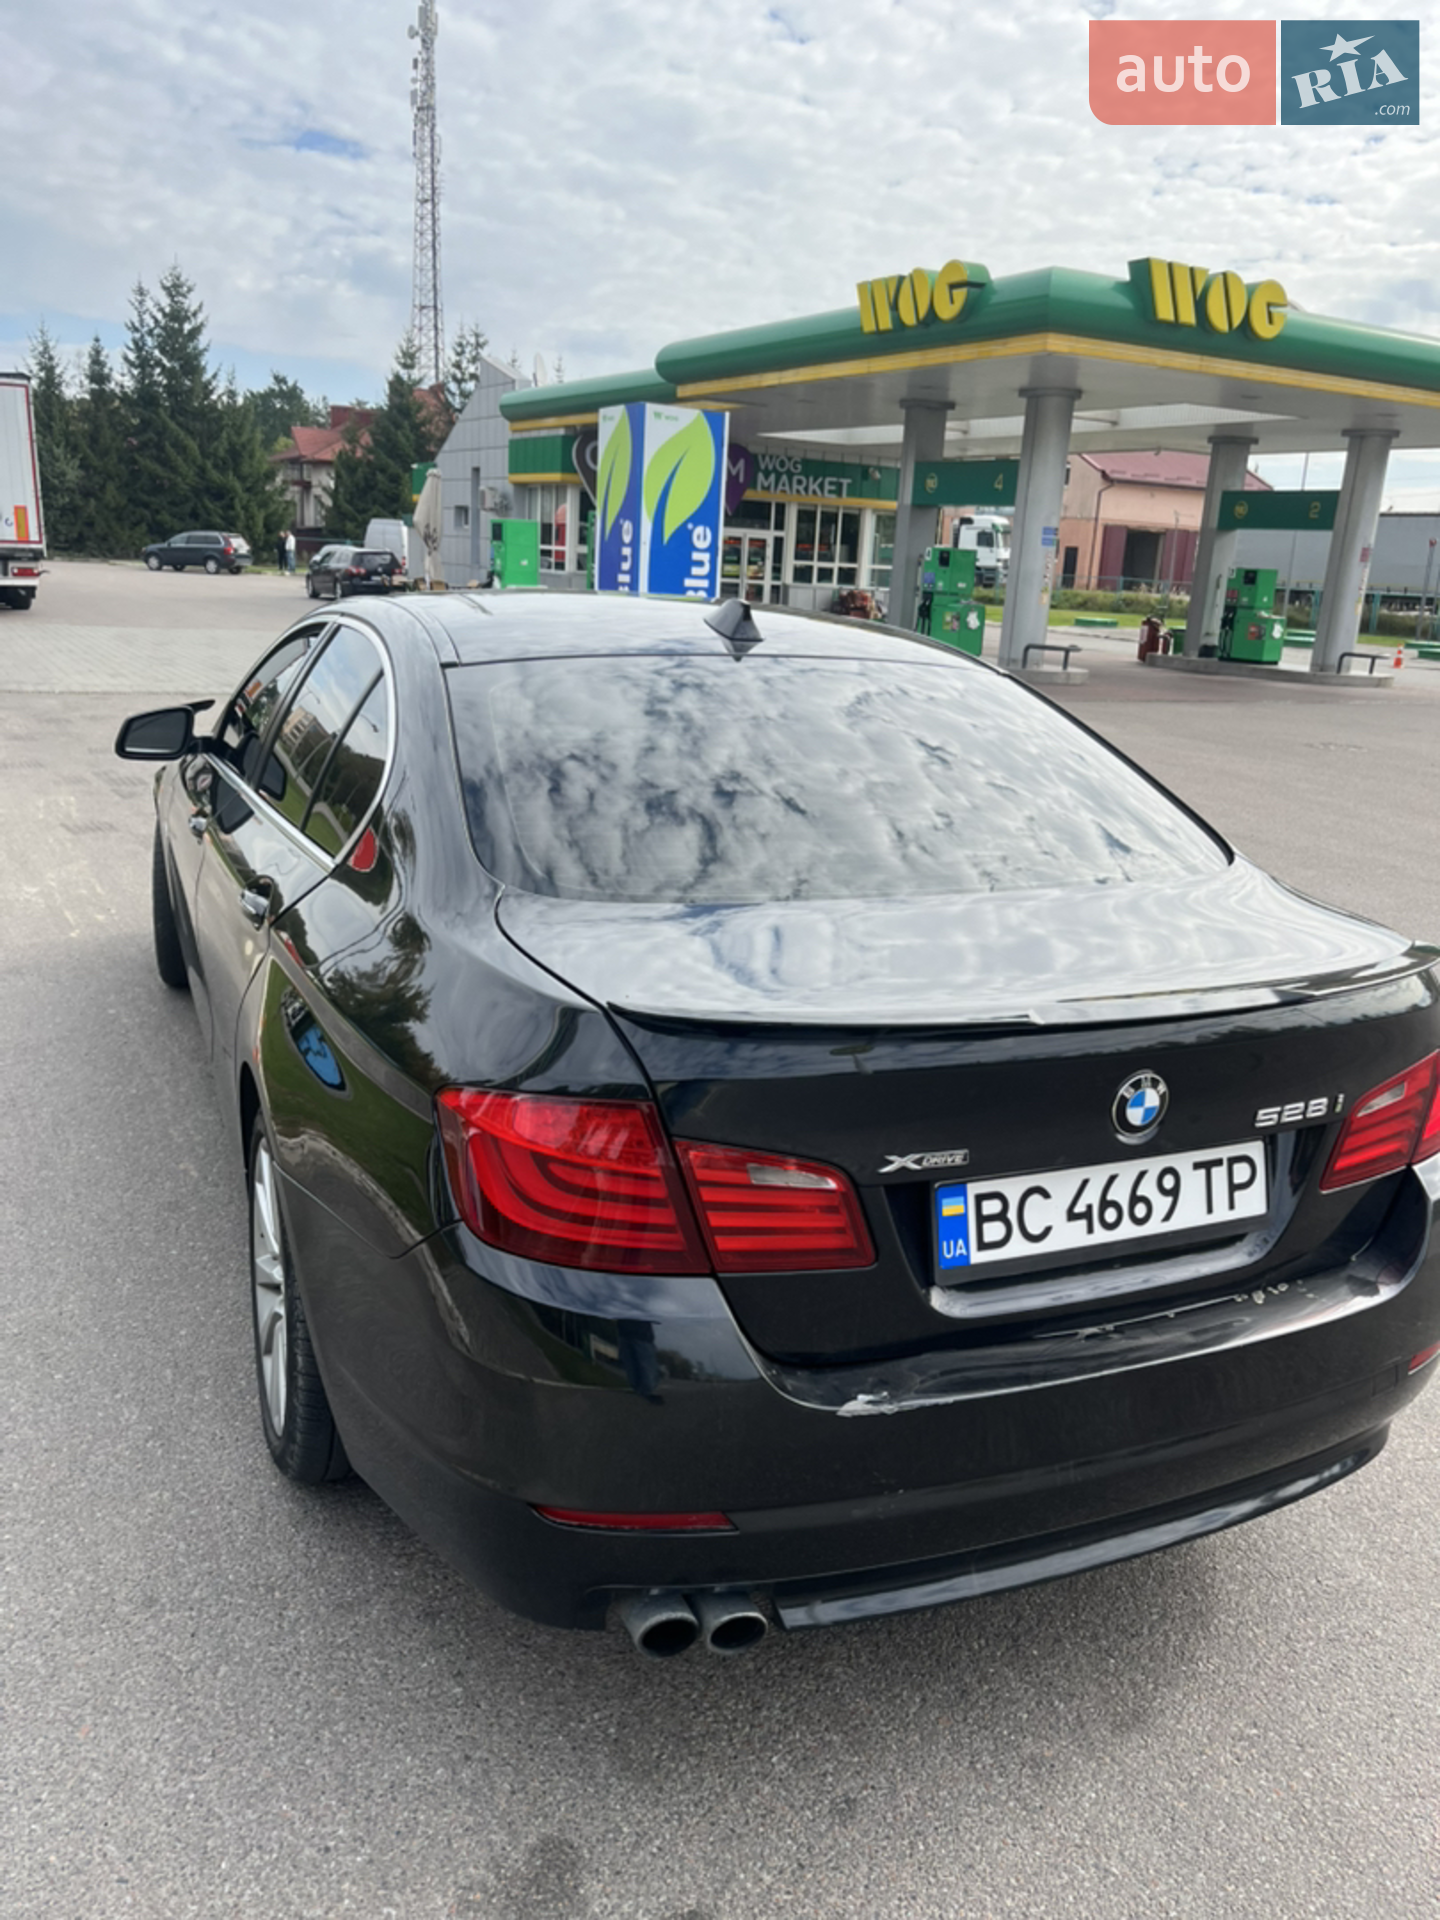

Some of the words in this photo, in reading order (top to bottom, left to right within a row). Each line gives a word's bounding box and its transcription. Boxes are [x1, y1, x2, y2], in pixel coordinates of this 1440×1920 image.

[857, 259, 990, 334] WOG
[1149, 257, 1288, 340] WOG
[757, 454, 802, 473] WOG
[756, 473, 852, 499] MARKET
[1309, 501, 1321, 519] 2
[974, 1185, 1053, 1252] BC
[1066, 1166, 1181, 1235] 4669
[1193, 1154, 1258, 1215] TP
[942, 1239, 967, 1259] UA
